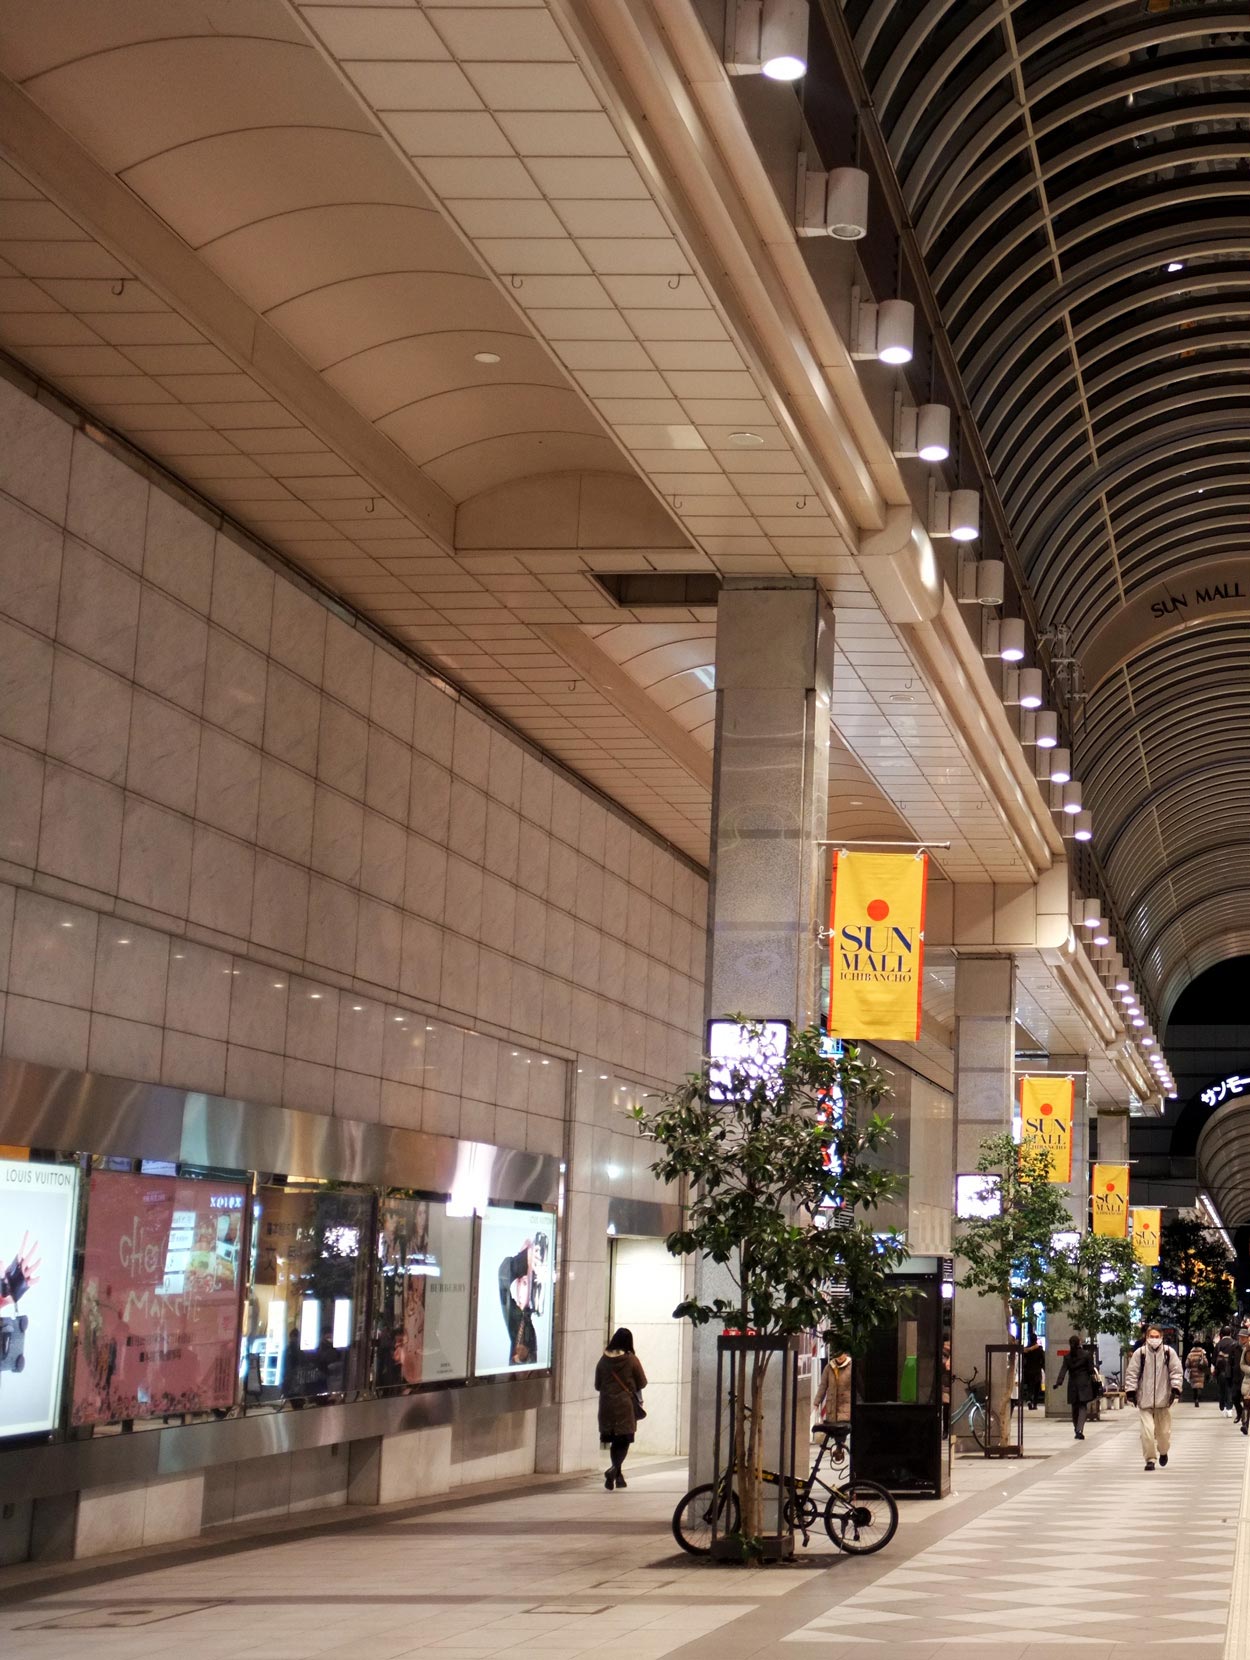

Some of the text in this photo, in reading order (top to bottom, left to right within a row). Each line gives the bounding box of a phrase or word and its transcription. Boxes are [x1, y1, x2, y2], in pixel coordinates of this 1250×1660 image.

[1151, 594, 1188, 619] SUN
[1196, 583, 1246, 604] MALL
[840, 925, 915, 954] SUN
[841, 953, 912, 973] MALL
[840, 972, 912, 983] ICHIBANCHO
[1025, 1118, 1067, 1134] SUN
[6, 1169, 71, 1186] LOUIS VUITTON
[1095, 1193, 1124, 1204] SUN
[1096, 1203, 1123, 1212] MALL
[1135, 1231, 1157, 1239] SUN
